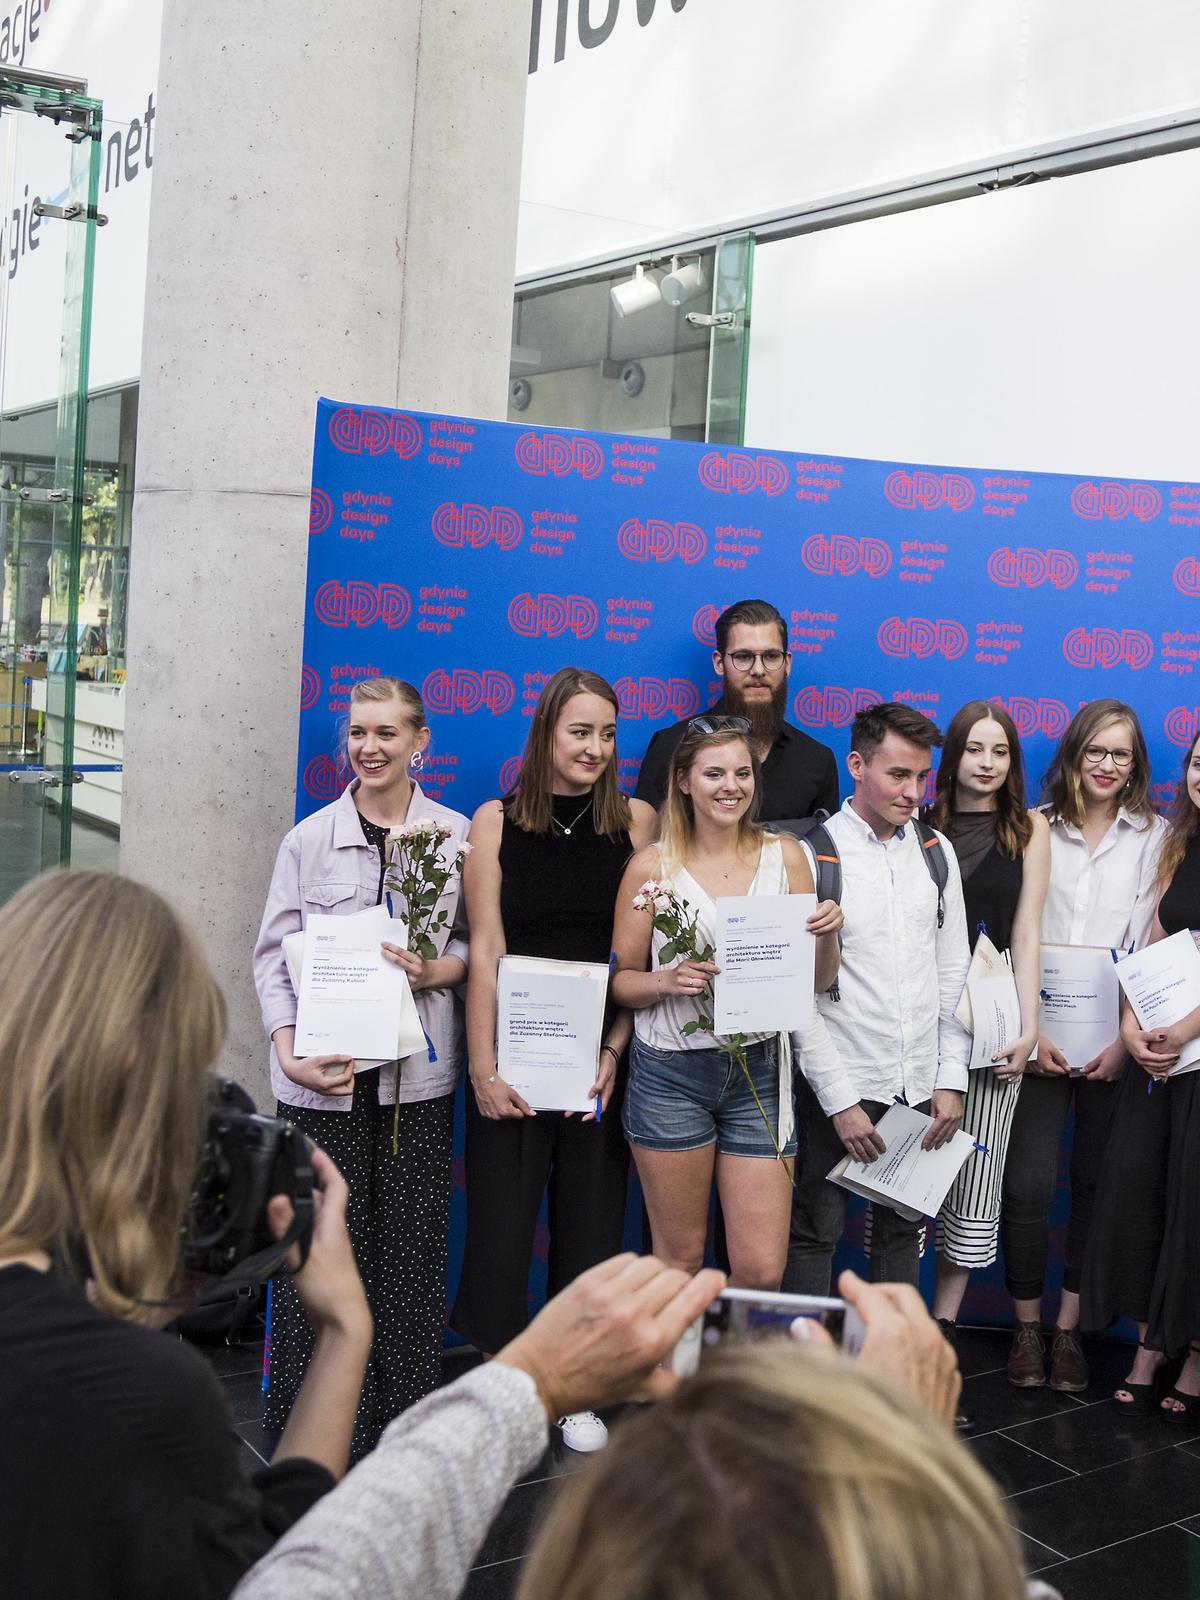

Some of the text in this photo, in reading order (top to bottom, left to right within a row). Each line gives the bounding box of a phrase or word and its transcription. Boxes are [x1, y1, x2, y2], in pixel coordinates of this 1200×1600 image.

[105, 92, 156, 193] net
[431, 420, 475, 435] gdynia
[429, 435, 473, 454] design
[612, 442, 657, 456] gdynia
[429, 452, 460, 468] days
[611, 456, 656, 473] design
[797, 461, 843, 473] gdynia
[611, 472, 644, 486] days
[797, 474, 840, 490] design
[983, 476, 1030, 490] gdynia
[343, 492, 391, 507] gdynia
[796, 490, 828, 503] days
[983, 490, 1028, 505] design
[342, 508, 388, 526] design
[532, 510, 577, 524] gdynia
[983, 505, 1015, 517] days
[1169, 515, 1200, 526] days
[340, 526, 374, 542] days
[531, 526, 575, 542] design
[715, 526, 761, 540] gdynia
[530, 542, 562, 557] days
[715, 542, 759, 557] design
[901, 541, 947, 553] gdynia
[714, 556, 746, 571] days
[900, 556, 944, 570] design
[1087, 551, 1132, 564] gdynia
[900, 570, 932, 584] days
[1086, 566, 1131, 582] design
[420, 586, 467, 600] gdynia
[1085, 581, 1117, 594] days
[419, 602, 464, 619] design
[608, 598, 652, 611] gdynia
[606, 613, 650, 630] design
[791, 608, 837, 623] gdynia
[418, 619, 451, 634] days
[790, 624, 835, 640] design
[977, 622, 1023, 635] gdynia
[606, 630, 637, 644] days
[976, 637, 1020, 652] design
[788, 640, 822, 655] days
[976, 652, 1007, 665] days
[330, 663, 380, 679] gdynia
[1160, 662, 1192, 674] days
[893, 688, 940, 703] gdynia
